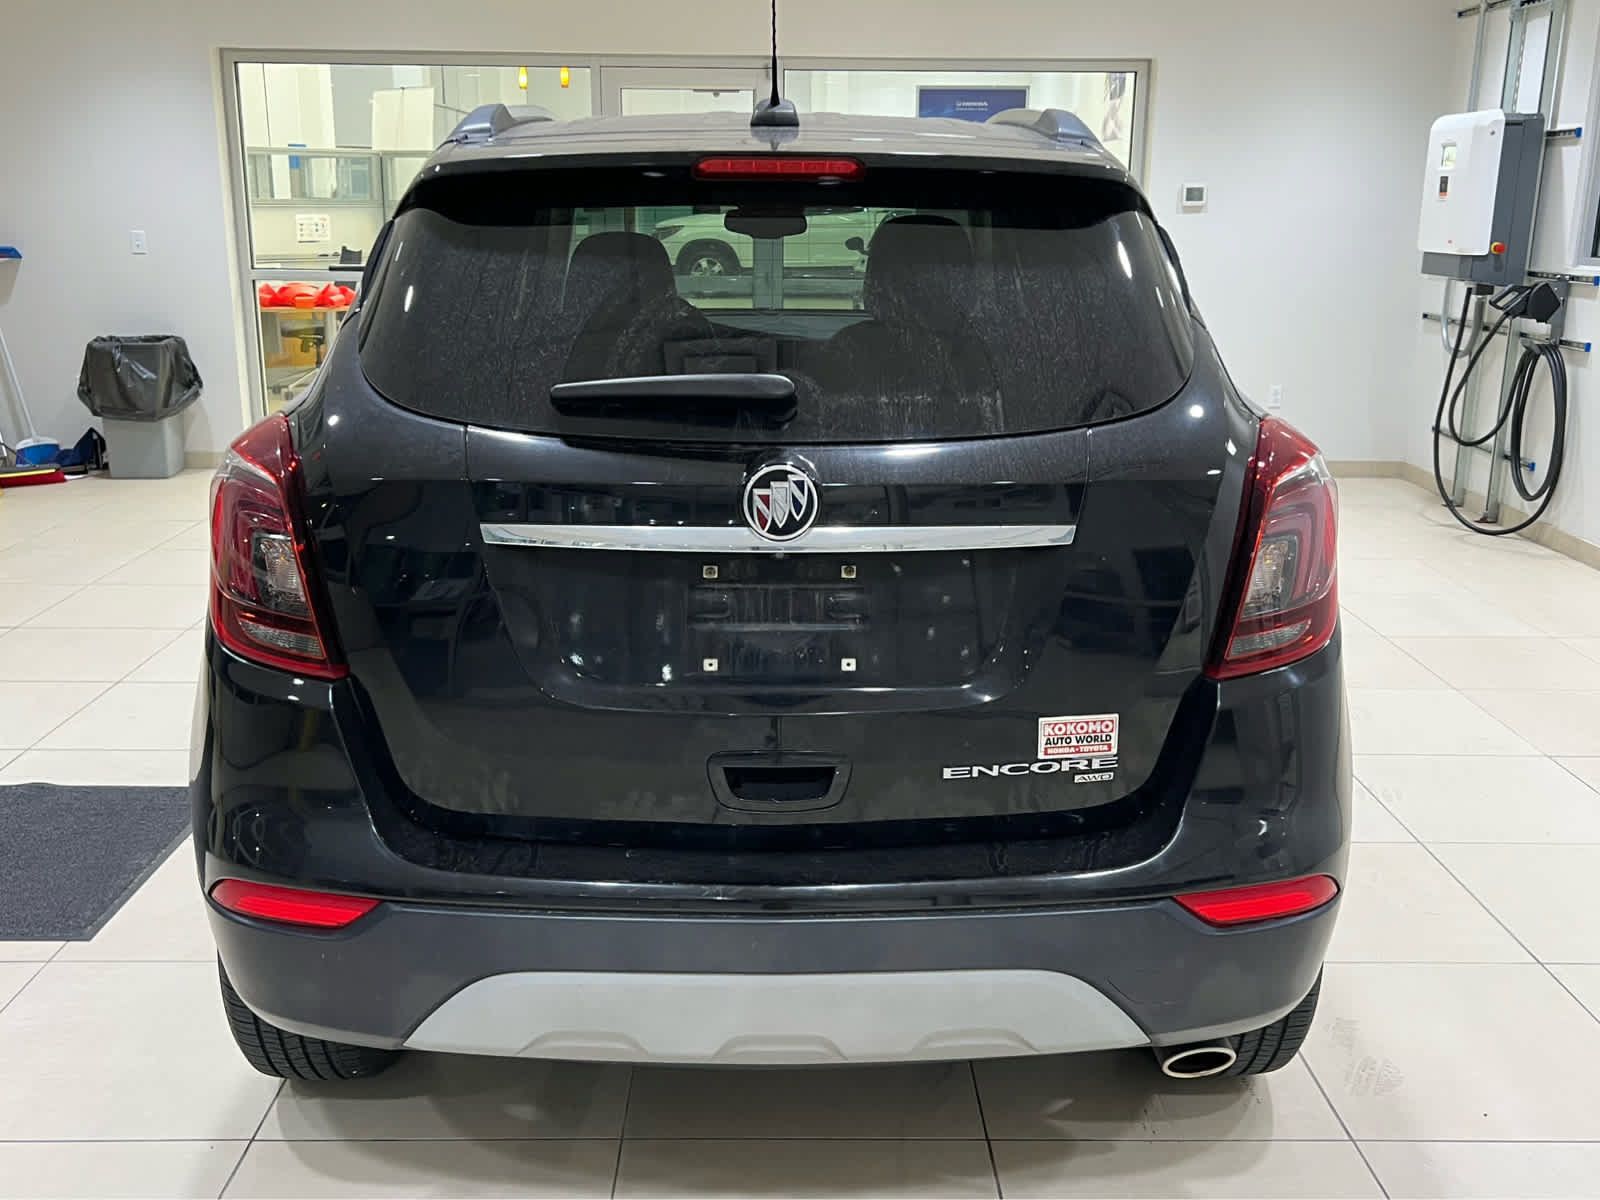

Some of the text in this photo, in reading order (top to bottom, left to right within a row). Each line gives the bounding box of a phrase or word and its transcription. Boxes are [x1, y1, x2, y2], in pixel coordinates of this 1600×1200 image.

[1044, 721, 1113, 736] KOKOMO
[1045, 734, 1112, 745] AUTO WORLD
[943, 757, 1119, 779] ENCORE
[1076, 773, 1113, 782] AWD
